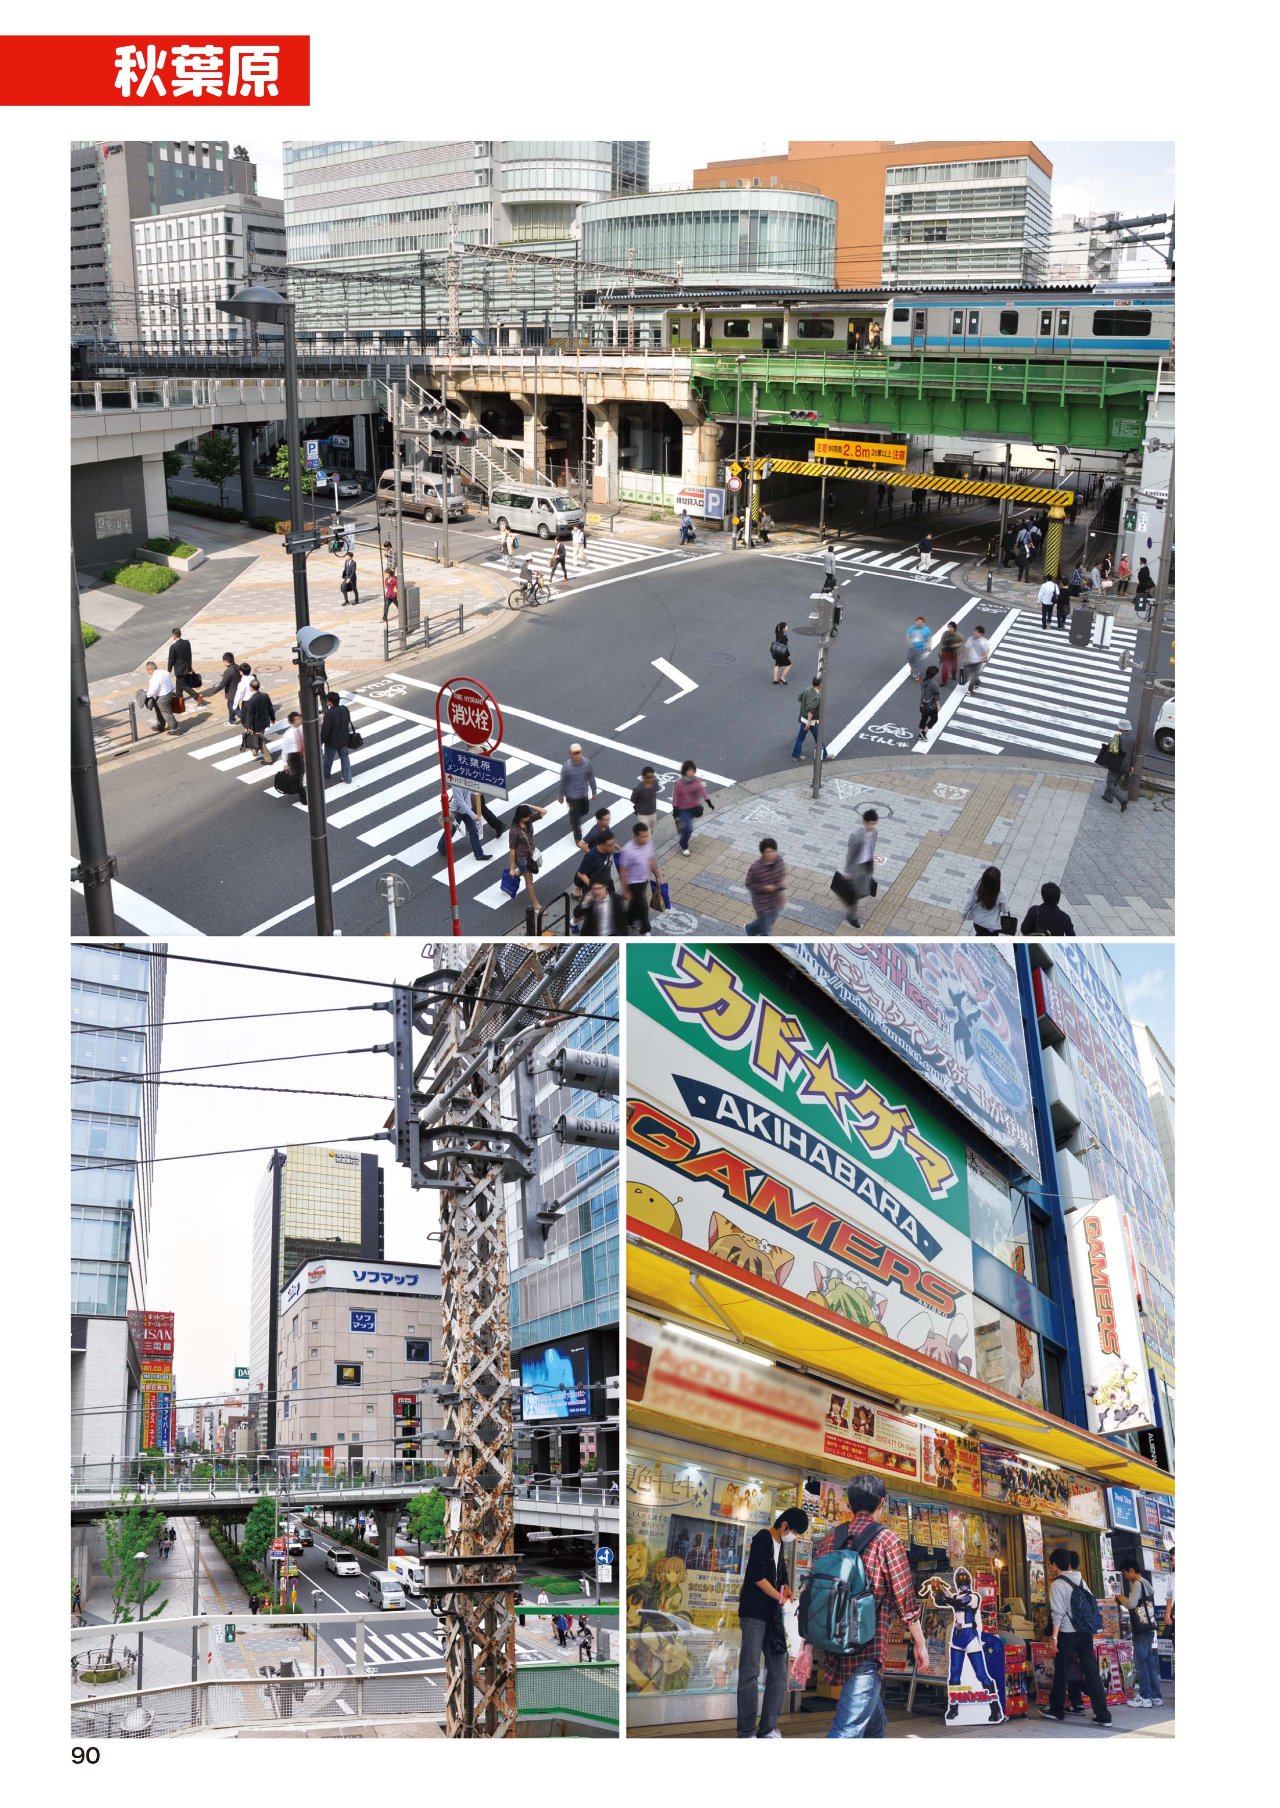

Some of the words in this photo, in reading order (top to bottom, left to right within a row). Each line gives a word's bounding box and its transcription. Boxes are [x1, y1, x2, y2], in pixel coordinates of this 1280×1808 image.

[843, 444, 870, 458] 2.8m
[892, 450, 905, 461] 注意
[708, 495, 720, 513] P
[451, 702, 489, 732] 消火栓
[457, 754, 491, 771] 秋葉原
[447, 764, 505, 785] メンタルクリニック
[577, 1053, 608, 1068] NS40
[715, 1094, 920, 1244] AKIHABARA
[627, 1100, 970, 1313] GAMERS
[353, 1270, 419, 1286] ソフマップ
[1082, 1215, 1121, 1359] GAMERS
[352, 1321, 375, 1330] マップ
[355, 1314, 371, 1322] ソフ
[1114, 1491, 1125, 1502] Real
